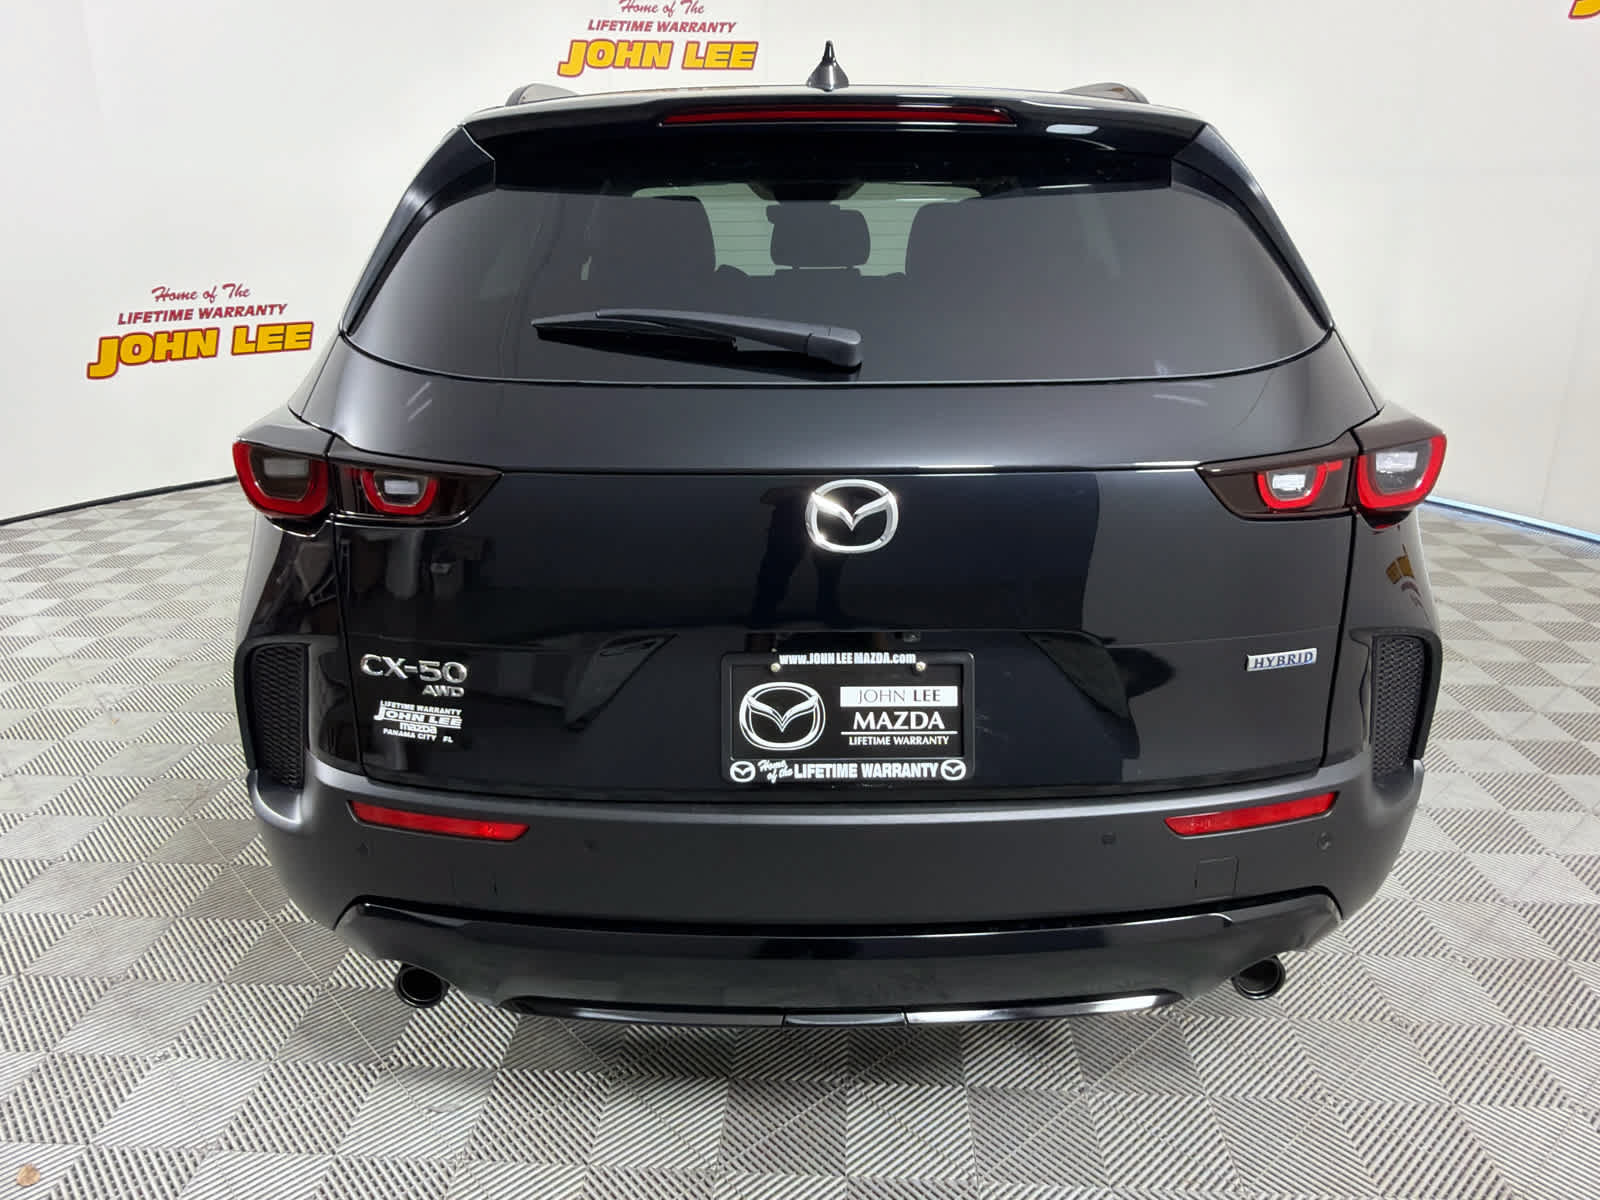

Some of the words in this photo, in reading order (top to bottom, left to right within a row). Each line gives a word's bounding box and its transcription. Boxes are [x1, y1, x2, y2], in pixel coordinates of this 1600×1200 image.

[618, 0, 658, 14] Home
[663, 3, 676, 17] of
[680, 0, 705, 15] The
[588, 19, 653, 32] LIFETIME
[656, 21, 736, 33] WARRANTY
[557, 39, 674, 77] JOHN
[682, 41, 759, 71] LEE
[151, 285, 198, 302] Home
[202, 285, 217, 304] of
[222, 283, 251, 299] The
[118, 308, 194, 326] LIFETIME
[199, 303, 288, 320] WARRANTY
[86, 327, 220, 380] JOHN
[231, 321, 314, 356] LEE
[360, 653, 468, 684] CX-50
[1253, 651, 1314, 669] HYBRID
[422, 684, 465, 698] AWD
[858, 688, 905, 704] JOHN
[913, 689, 941, 702] LEE
[373, 704, 425, 722] JOHN
[429, 714, 462, 727] LEE
[380, 700, 415, 711] LIFETIME
[416, 704, 462, 716] WARRANTY
[853, 711, 945, 730] MAZDA
[382, 727, 416, 739] PANAMA
[417, 733, 437, 742] CITY
[849, 736, 891, 746] LIFETIME
[893, 735, 950, 746] WARRANTY
[757, 759, 787, 773] Home
[794, 763, 858, 779] LIFETIME
[861, 762, 939, 779] WARRANTY
